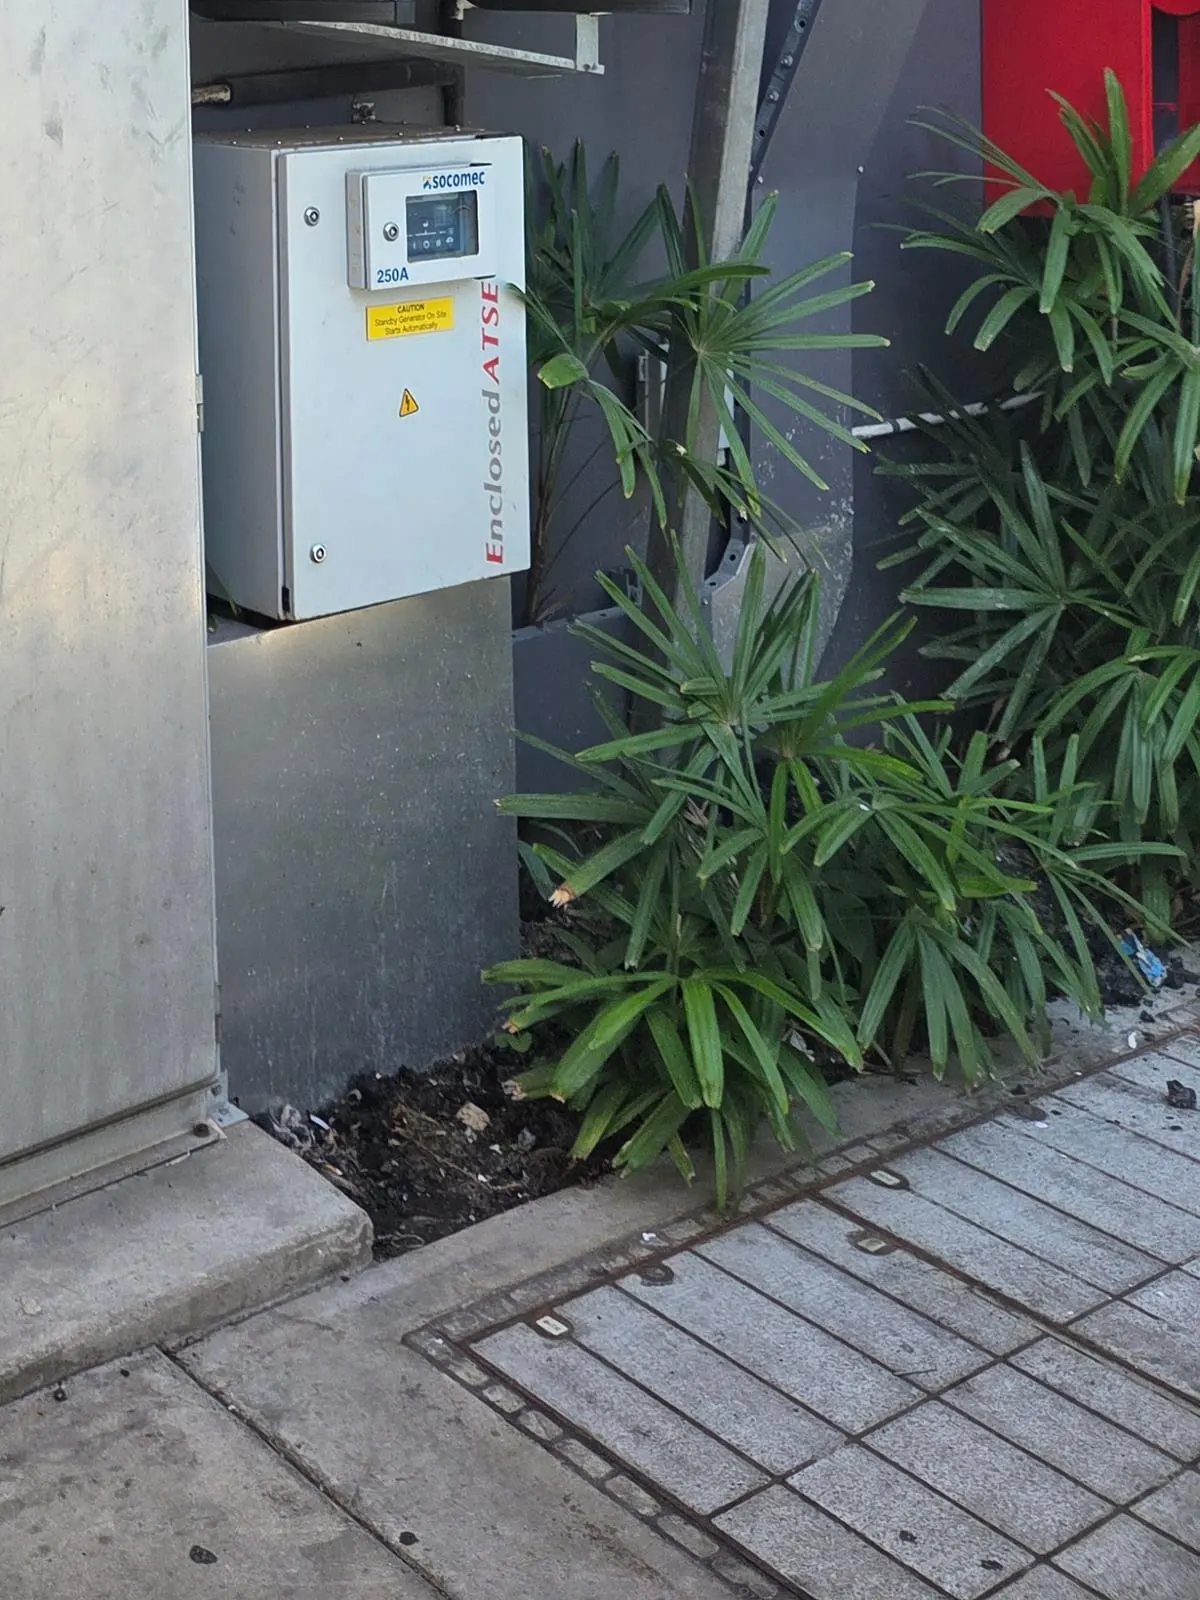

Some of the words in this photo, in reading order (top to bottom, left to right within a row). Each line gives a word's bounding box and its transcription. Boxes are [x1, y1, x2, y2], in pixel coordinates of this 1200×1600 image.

[432, 171, 485, 189] socomec
[376, 267, 409, 283] 250A
[397, 303, 425, 314] CAUTION
[398, 314, 426, 324] Generator
[426, 312, 435, 320] On
[436, 310, 447, 319] Site
